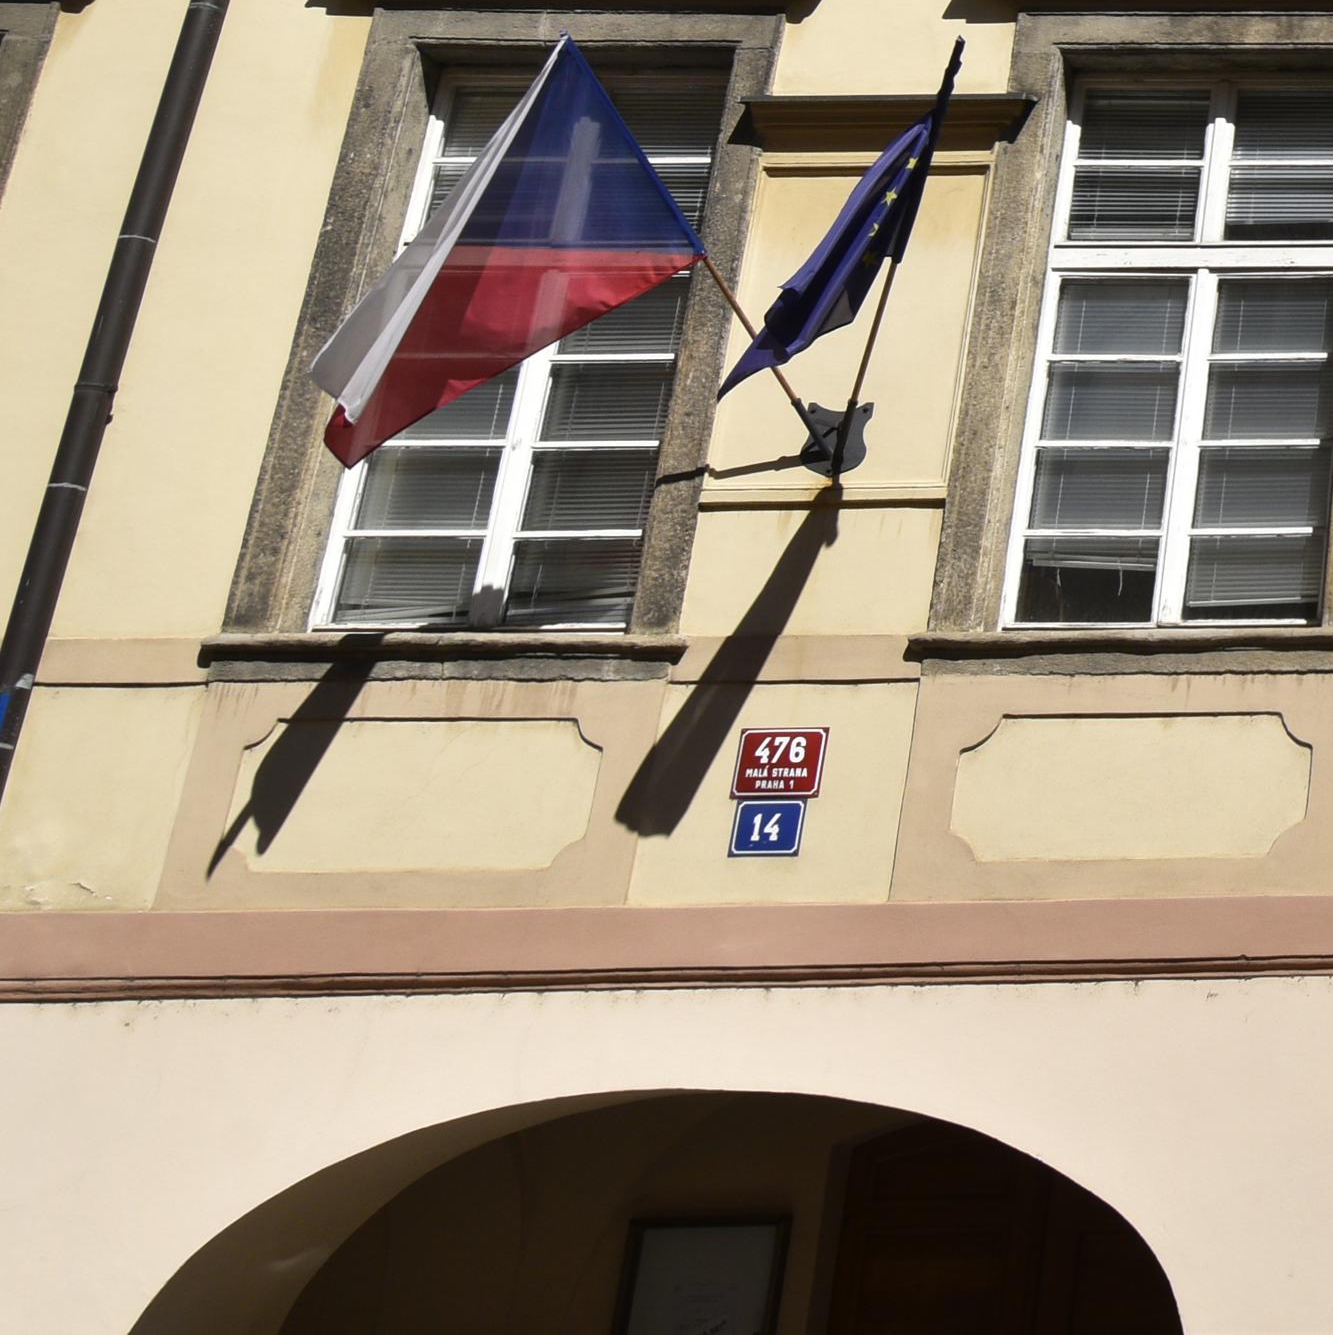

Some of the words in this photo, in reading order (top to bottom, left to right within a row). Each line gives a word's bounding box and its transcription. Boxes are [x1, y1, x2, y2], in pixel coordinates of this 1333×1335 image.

[755, 736, 807, 763] 476
[745, 765, 769, 778] MALÁ
[772, 767, 808, 778] STRANA
[755, 780, 785, 790] PRAHA
[789, 780, 794, 789] 1
[750, 813, 782, 841] 14
